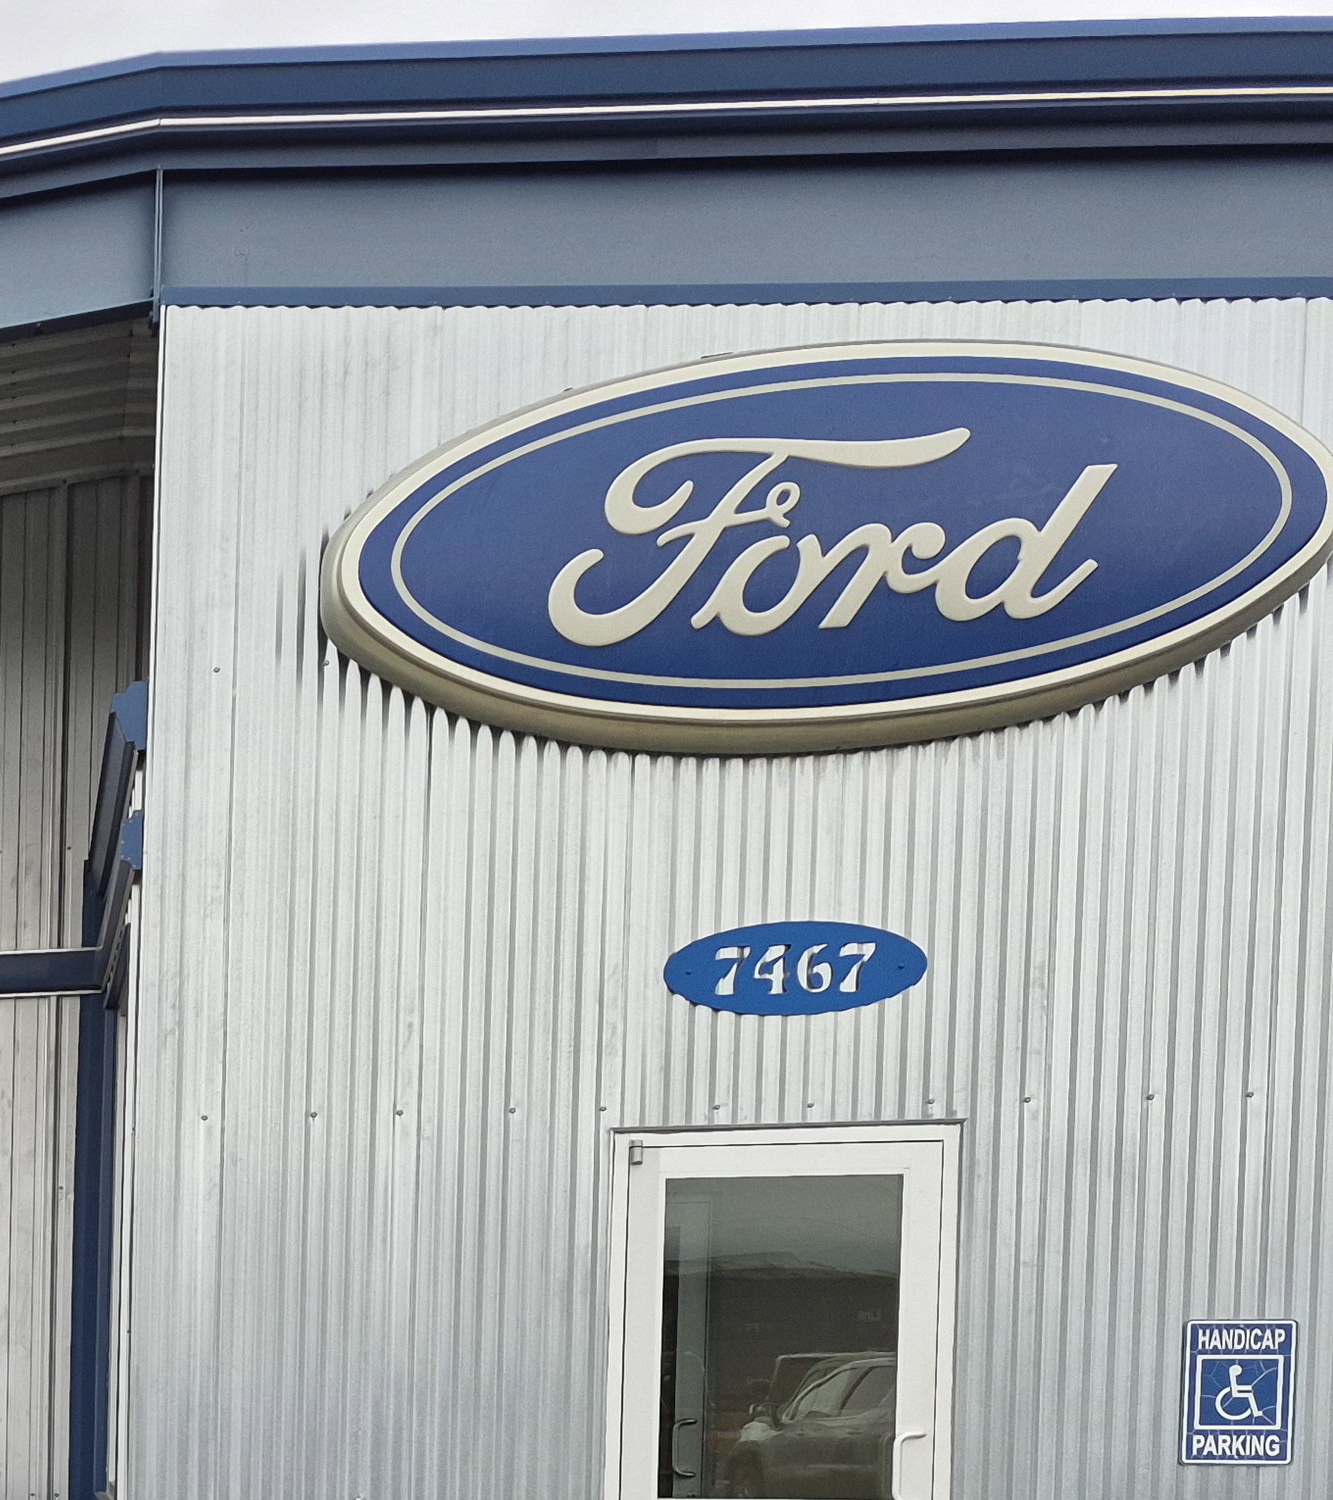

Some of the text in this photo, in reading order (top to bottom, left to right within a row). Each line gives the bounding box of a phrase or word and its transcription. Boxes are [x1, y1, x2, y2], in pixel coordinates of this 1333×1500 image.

[548, 427, 1119, 647] Ford
[714, 942, 877, 995] 7467
[1198, 1328, 1286, 1350] HANDICAP
[1192, 1434, 1280, 1457] PARKING
